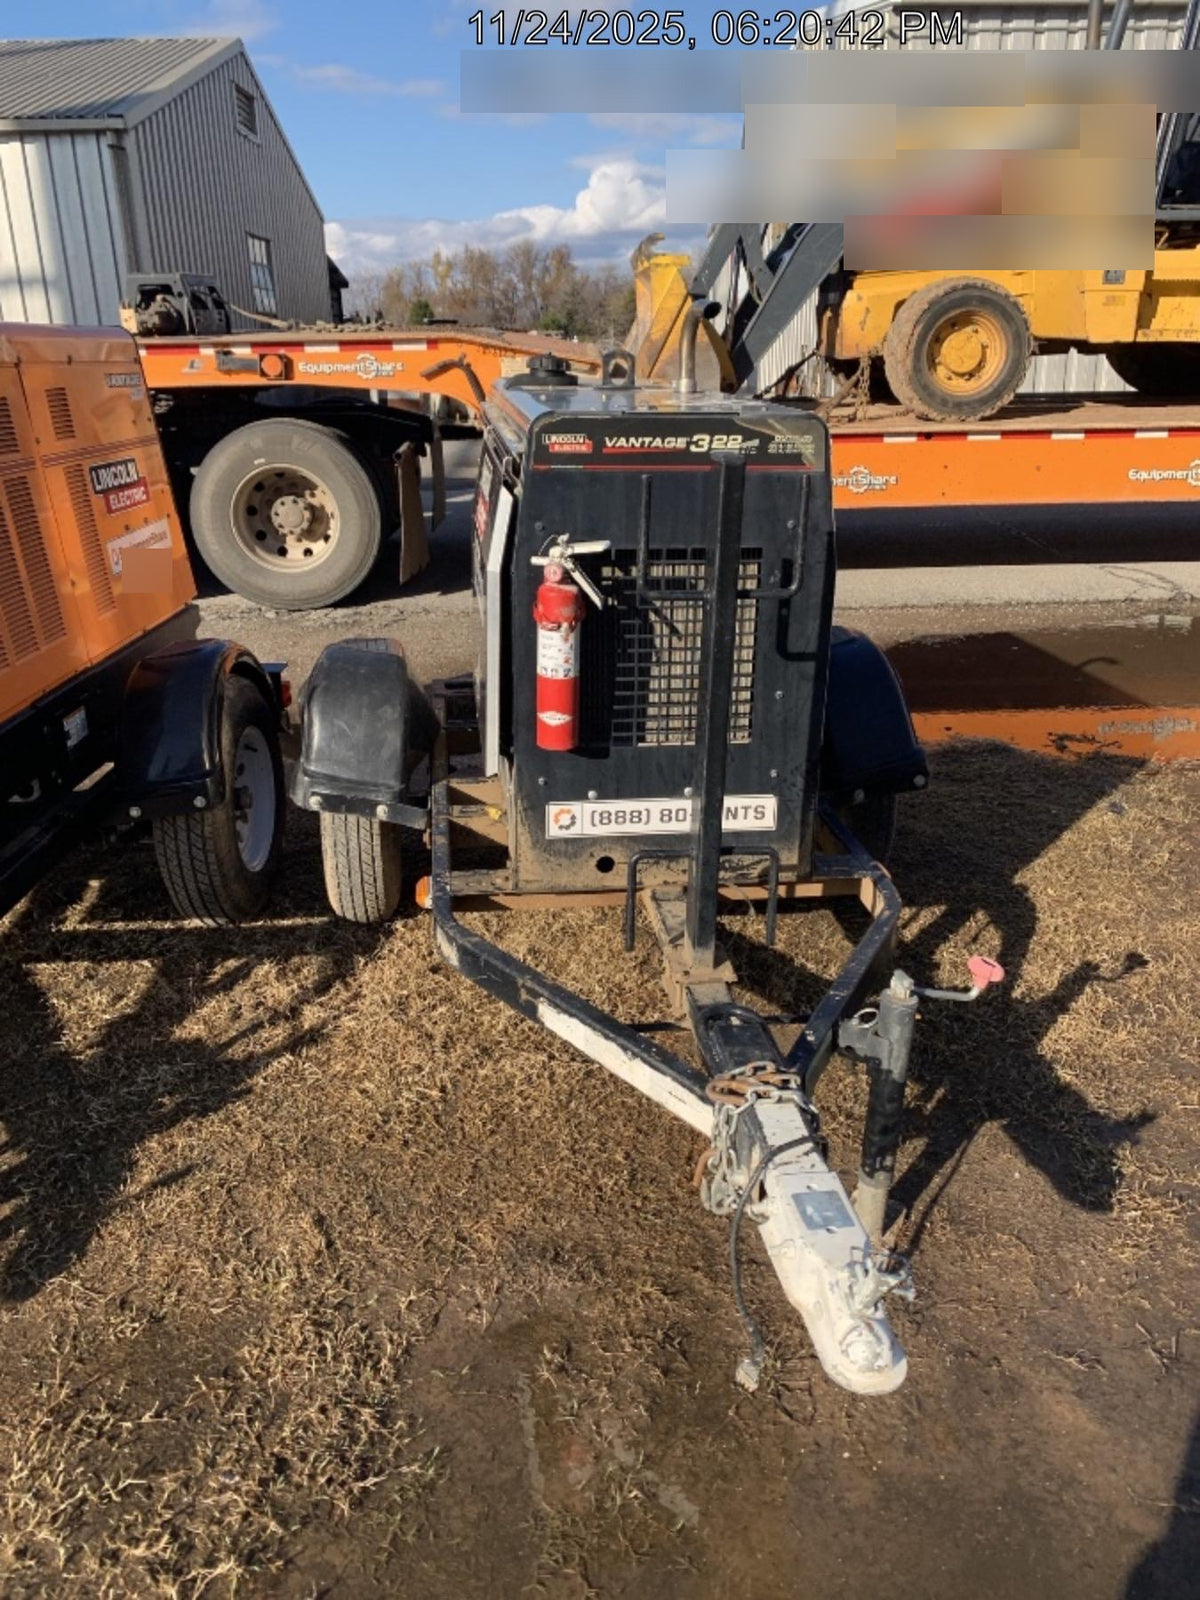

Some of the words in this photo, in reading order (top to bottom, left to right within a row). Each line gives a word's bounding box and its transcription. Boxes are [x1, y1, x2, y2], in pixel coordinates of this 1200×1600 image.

[298, 359, 404, 375] EquipmentShare
[604, 436, 688, 449] VANTAGE
[689, 433, 743, 453] 322
[91, 461, 138, 491] LINCOLN
[1128, 467, 1200, 483] Equipment
[109, 486, 147, 510] ELECTRIC
[590, 809, 650, 827] (888)
